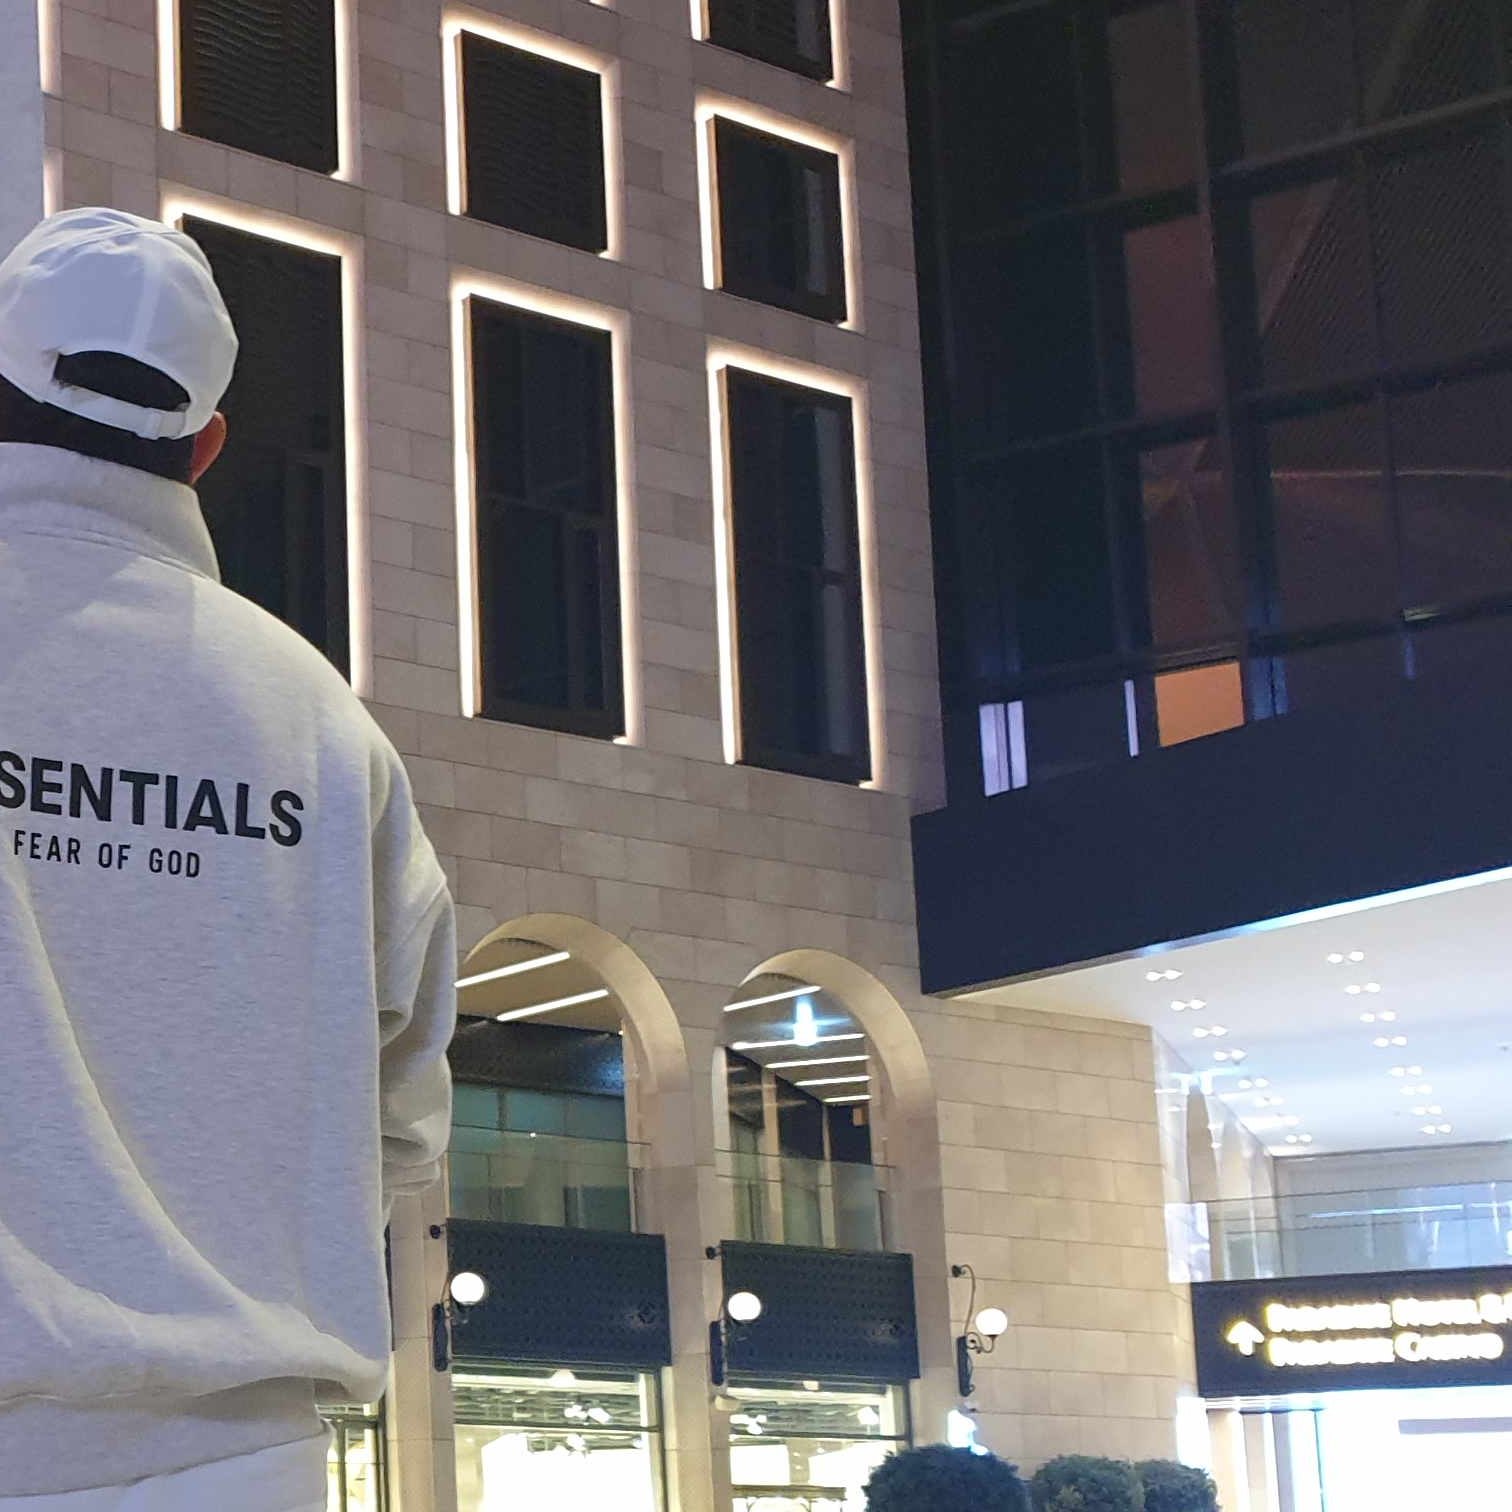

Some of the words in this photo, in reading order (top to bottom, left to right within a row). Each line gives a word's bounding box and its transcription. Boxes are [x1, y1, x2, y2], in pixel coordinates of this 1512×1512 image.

[14, 830, 80, 865] FEAR
[98, 843, 131, 870] OF
[149, 848, 200, 878] GOD
